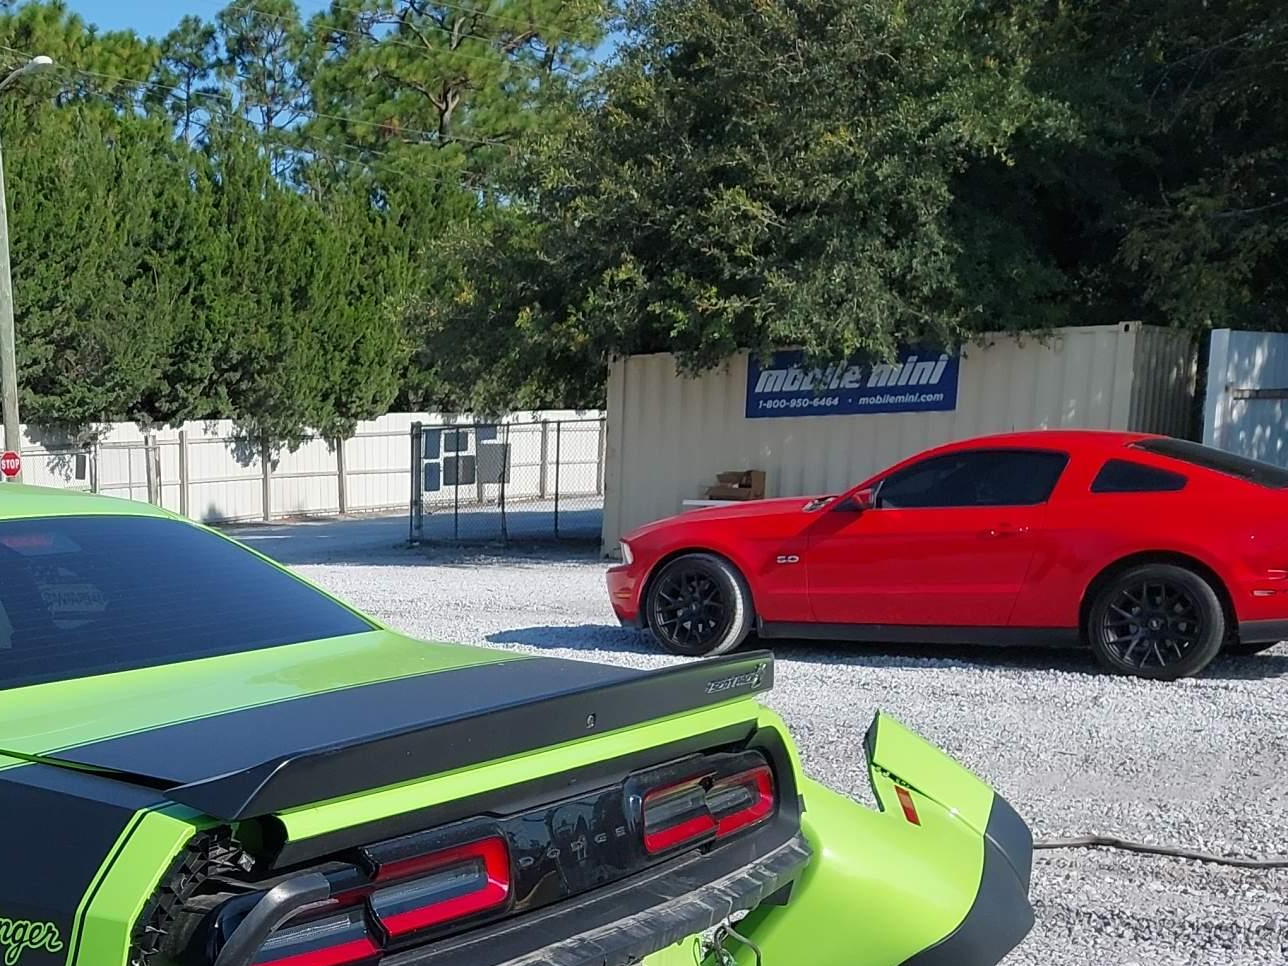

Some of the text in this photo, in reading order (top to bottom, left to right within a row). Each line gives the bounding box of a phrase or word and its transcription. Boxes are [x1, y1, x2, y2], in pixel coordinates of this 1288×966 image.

[866, 354, 949, 388] mini
[759, 392, 944, 409] 1-800-950-6464 mobilemini.com
[1, 459, 20, 470] STOP
